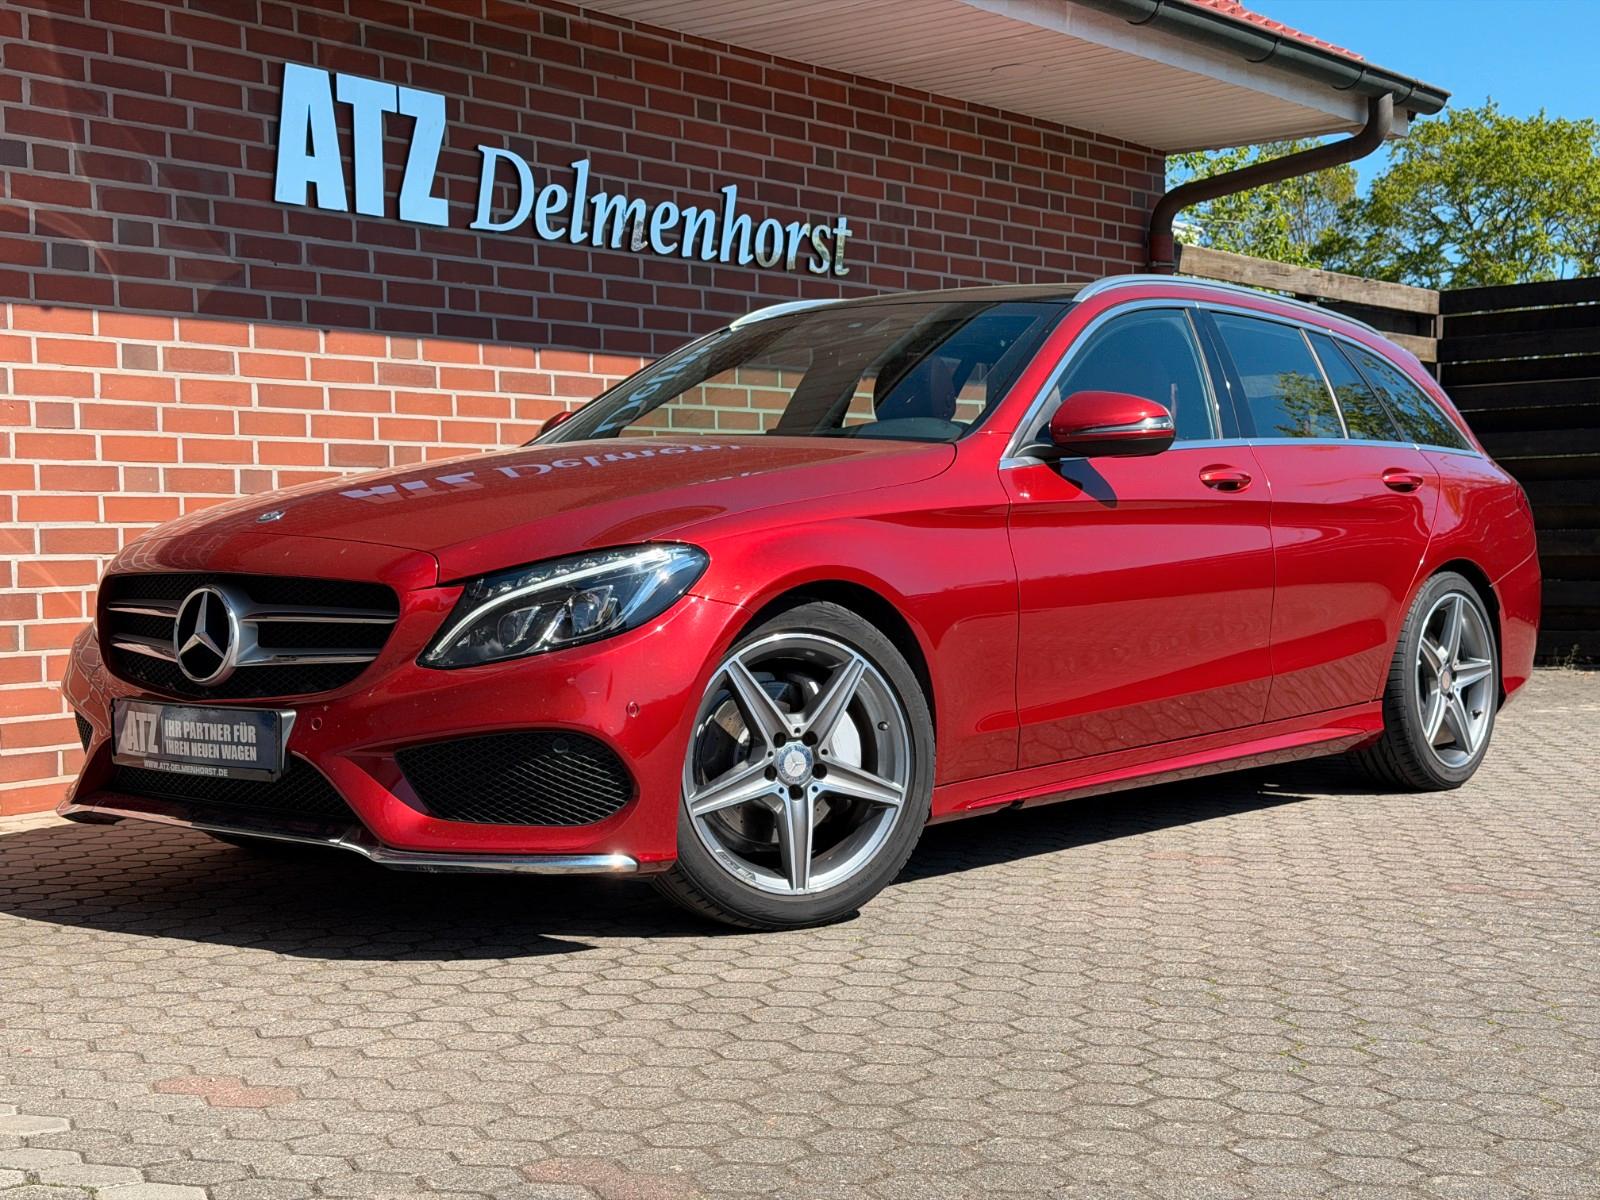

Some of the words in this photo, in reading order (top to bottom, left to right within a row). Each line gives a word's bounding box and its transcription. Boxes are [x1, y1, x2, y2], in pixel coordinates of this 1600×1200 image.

[274, 62, 449, 227] ATZ
[470, 144, 852, 276] Delmenhorst
[126, 710, 159, 754] ATZ
[165, 719, 182, 737] IHR
[183, 721, 231, 742] PARTNER
[233, 722, 256, 743] FÜR
[165, 739, 190, 755] IHREN
[191, 742, 220, 759] NEUEN
[221, 745, 257, 761] WAGEN
